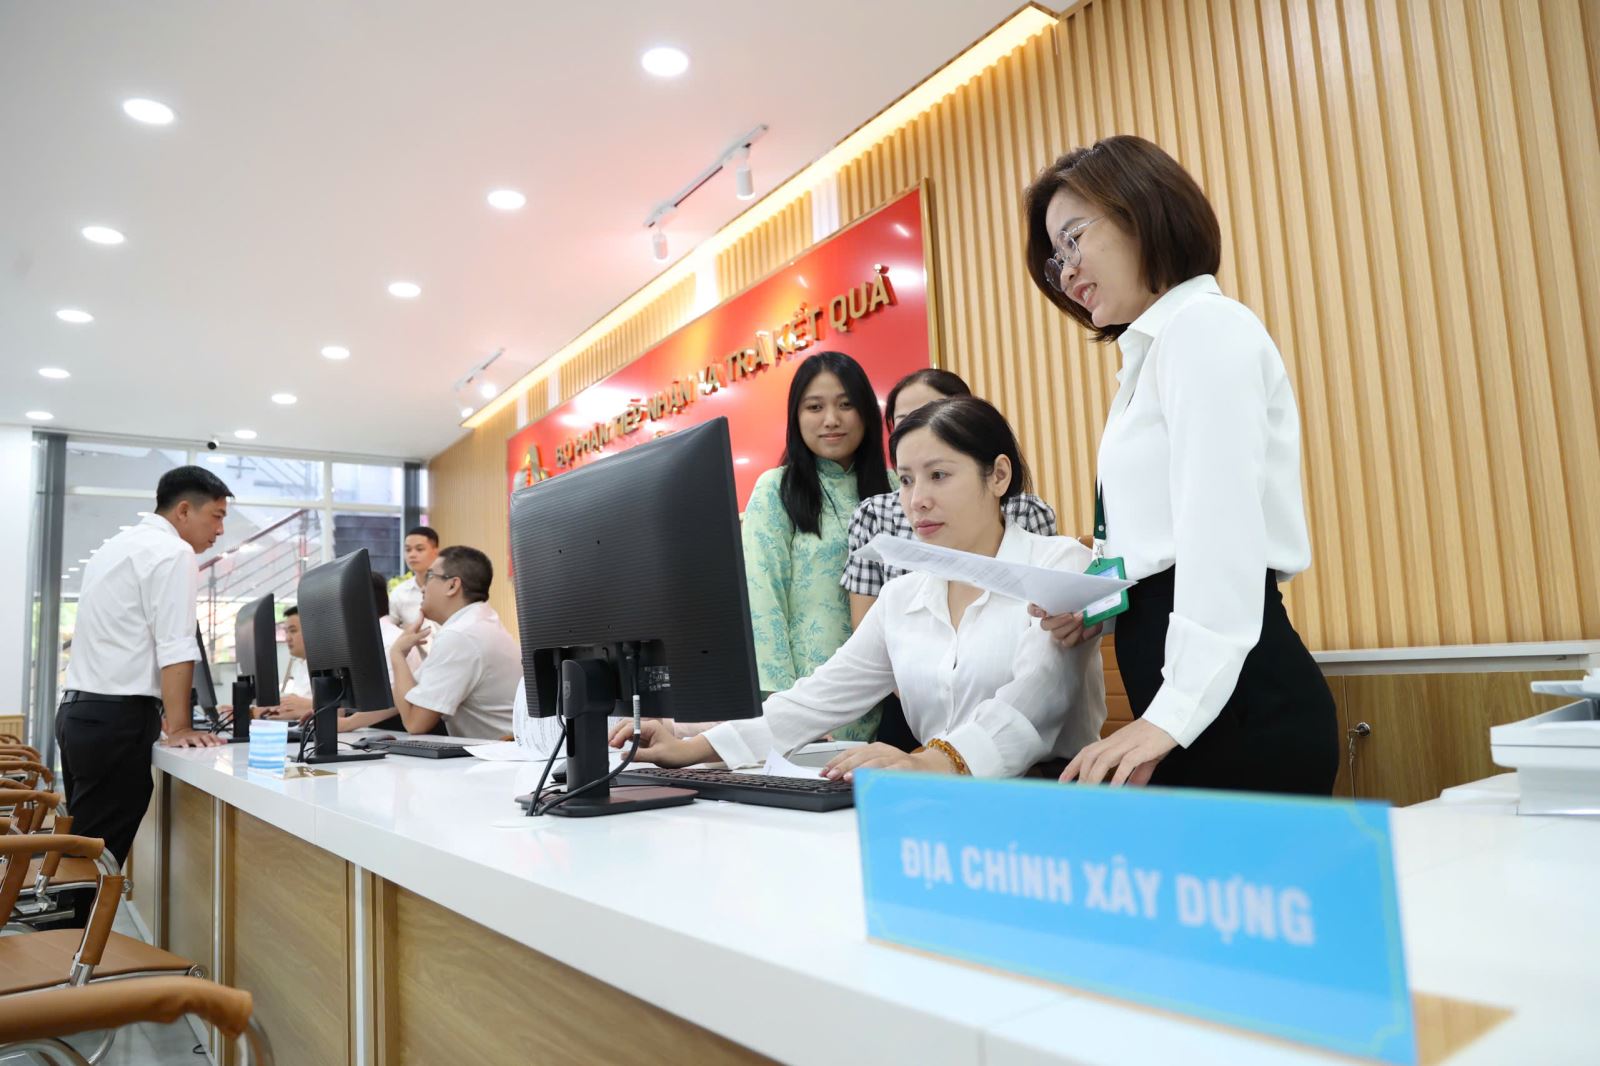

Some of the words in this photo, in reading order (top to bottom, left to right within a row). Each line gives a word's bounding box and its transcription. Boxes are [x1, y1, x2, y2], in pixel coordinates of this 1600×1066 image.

[829, 263, 891, 332] QUẢ
[900, 836, 954, 890] ĐỊA
[960, 841, 1073, 905] CHÍNH
[1082, 853, 1163, 920] XÂY
[1175, 873, 1317, 947] DỰNG
